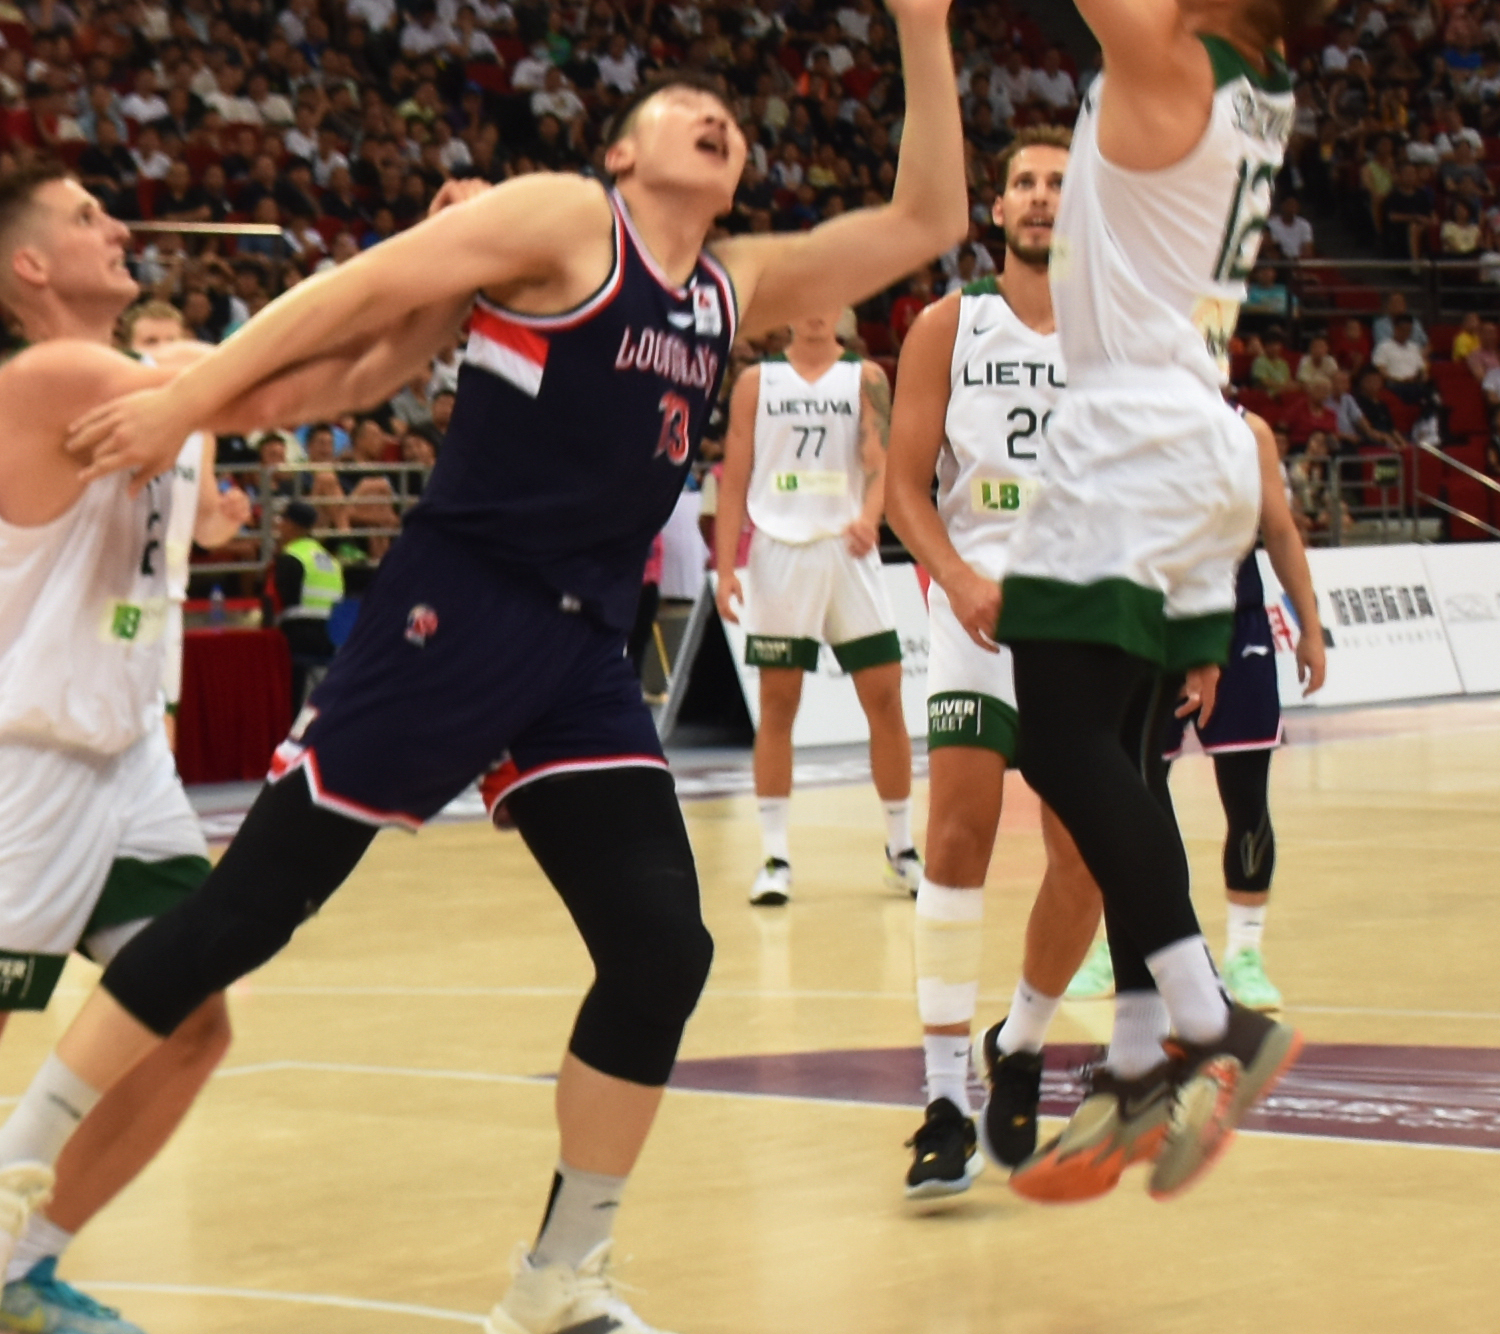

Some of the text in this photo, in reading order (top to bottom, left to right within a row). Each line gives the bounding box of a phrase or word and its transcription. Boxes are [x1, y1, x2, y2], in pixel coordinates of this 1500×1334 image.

[766, 398, 853, 416] LIETUVA
[791, 425, 827, 459] 77
[981, 482, 1020, 511] LB
